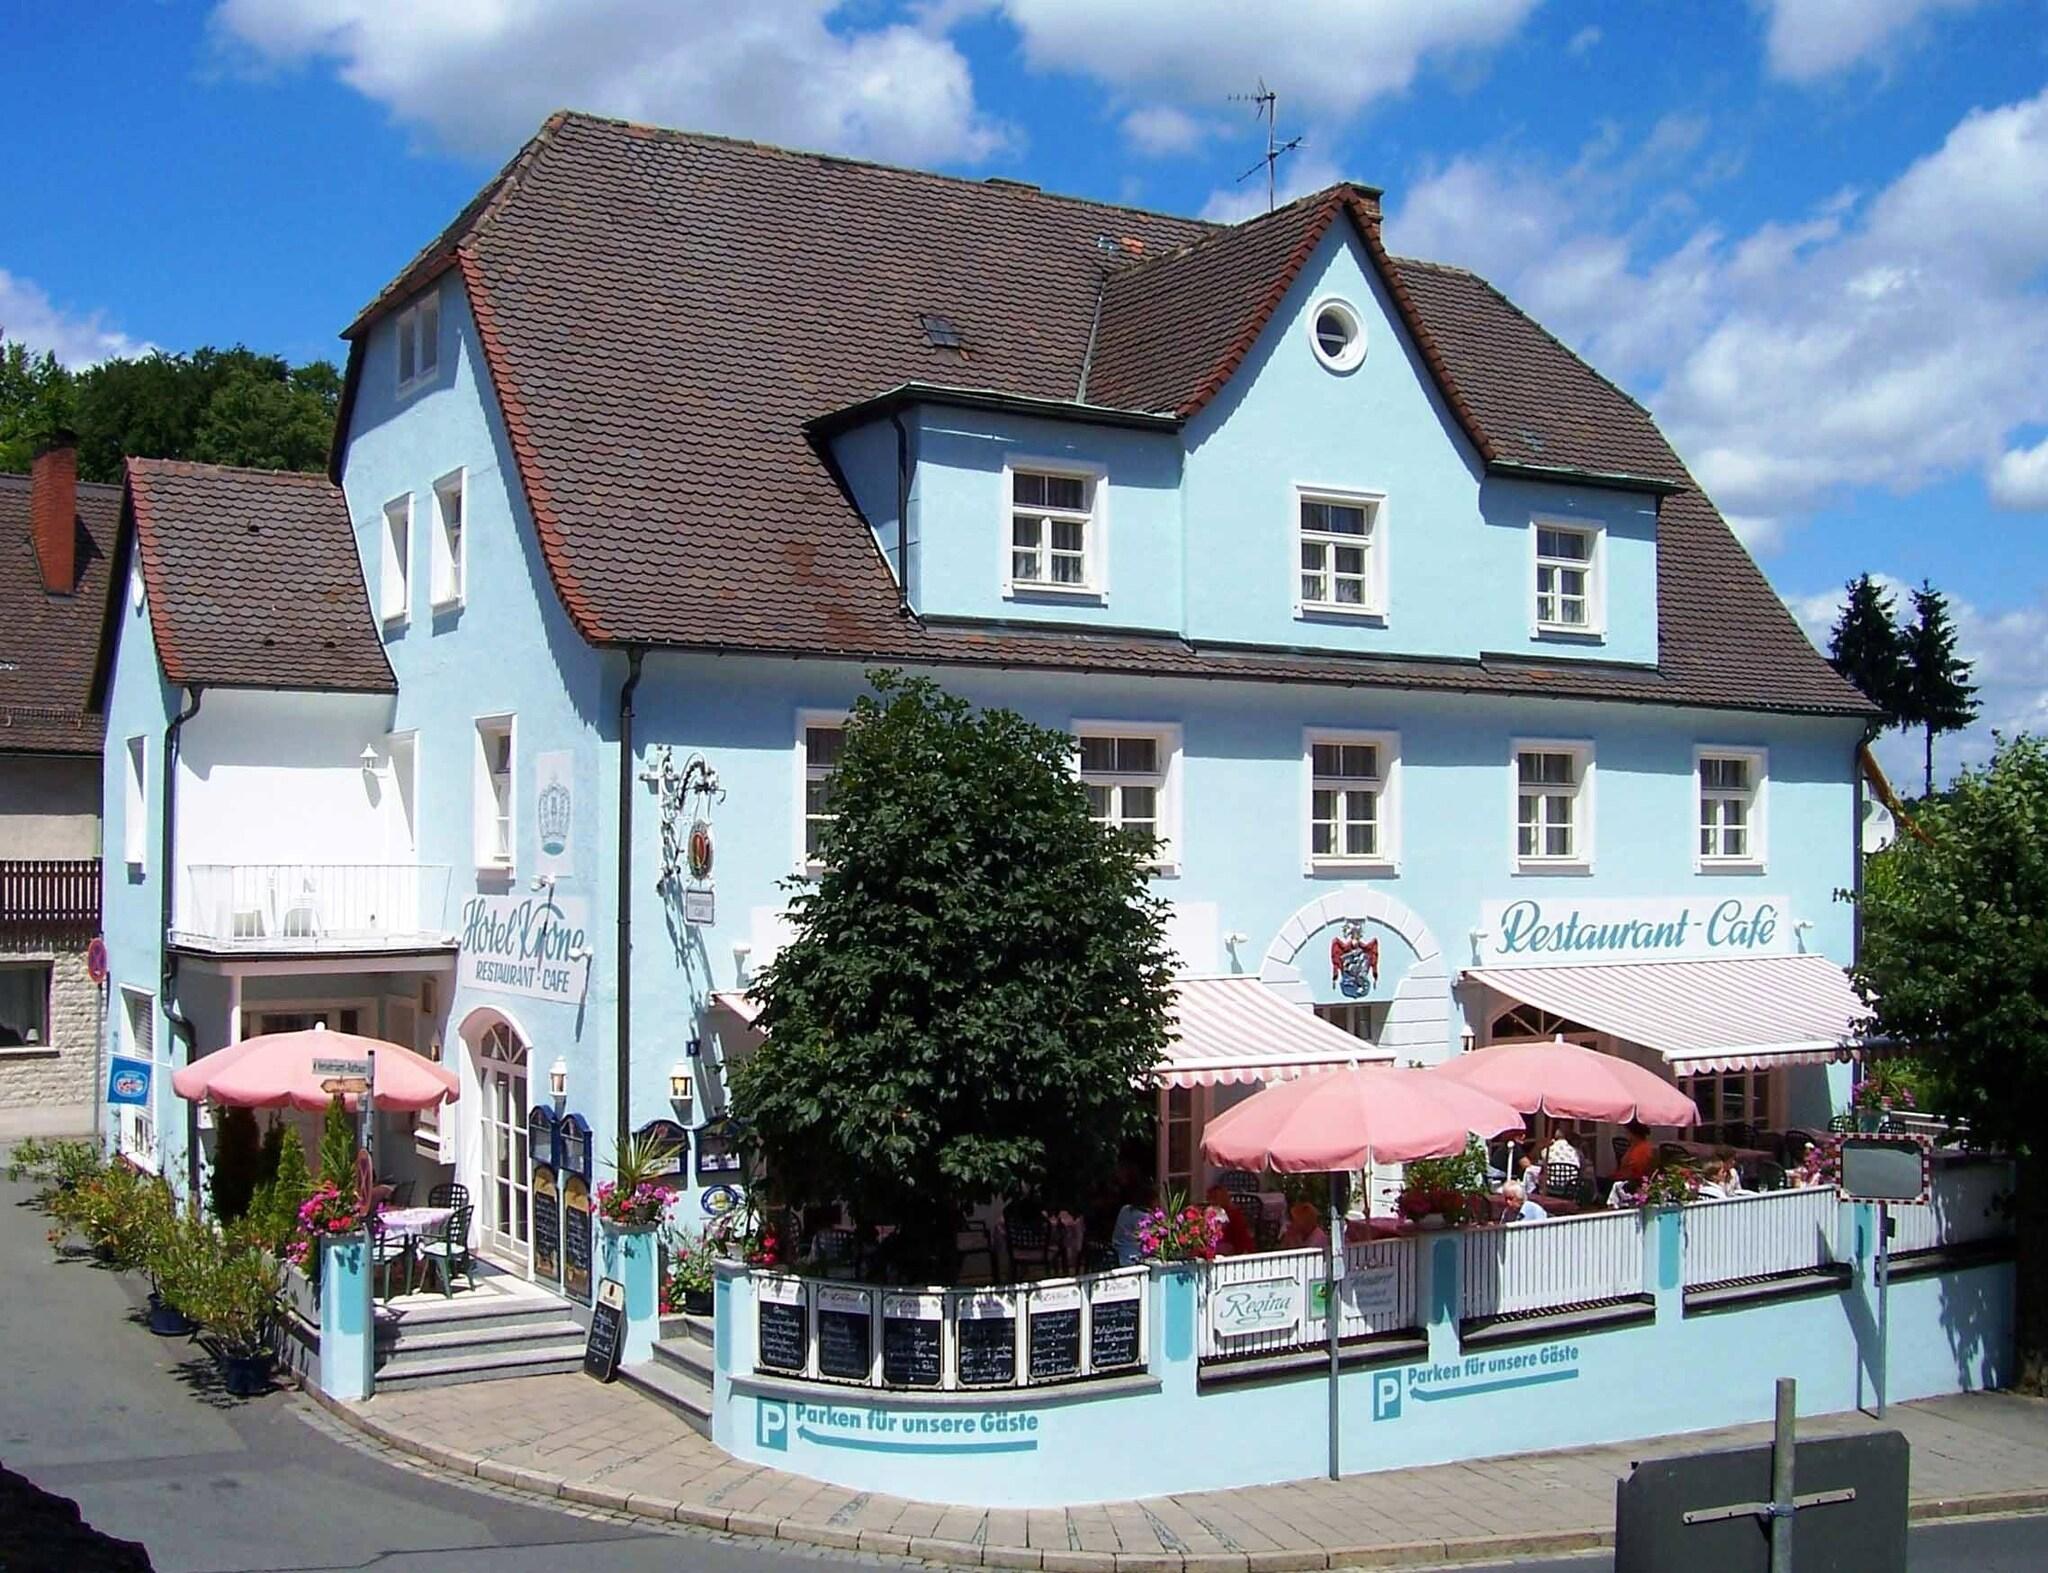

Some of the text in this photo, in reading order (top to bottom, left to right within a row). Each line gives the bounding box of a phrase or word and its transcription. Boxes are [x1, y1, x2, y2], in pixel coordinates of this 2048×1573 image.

[463, 898, 518, 956] Hotel
[475, 960, 571, 994] RESTAURANT CAFE
[1219, 1291, 1292, 1325] Regina
[1408, 1345, 1580, 1386] Parken für unsere Gäste
[795, 1402, 1039, 1434] Parken für unsere Gäste
